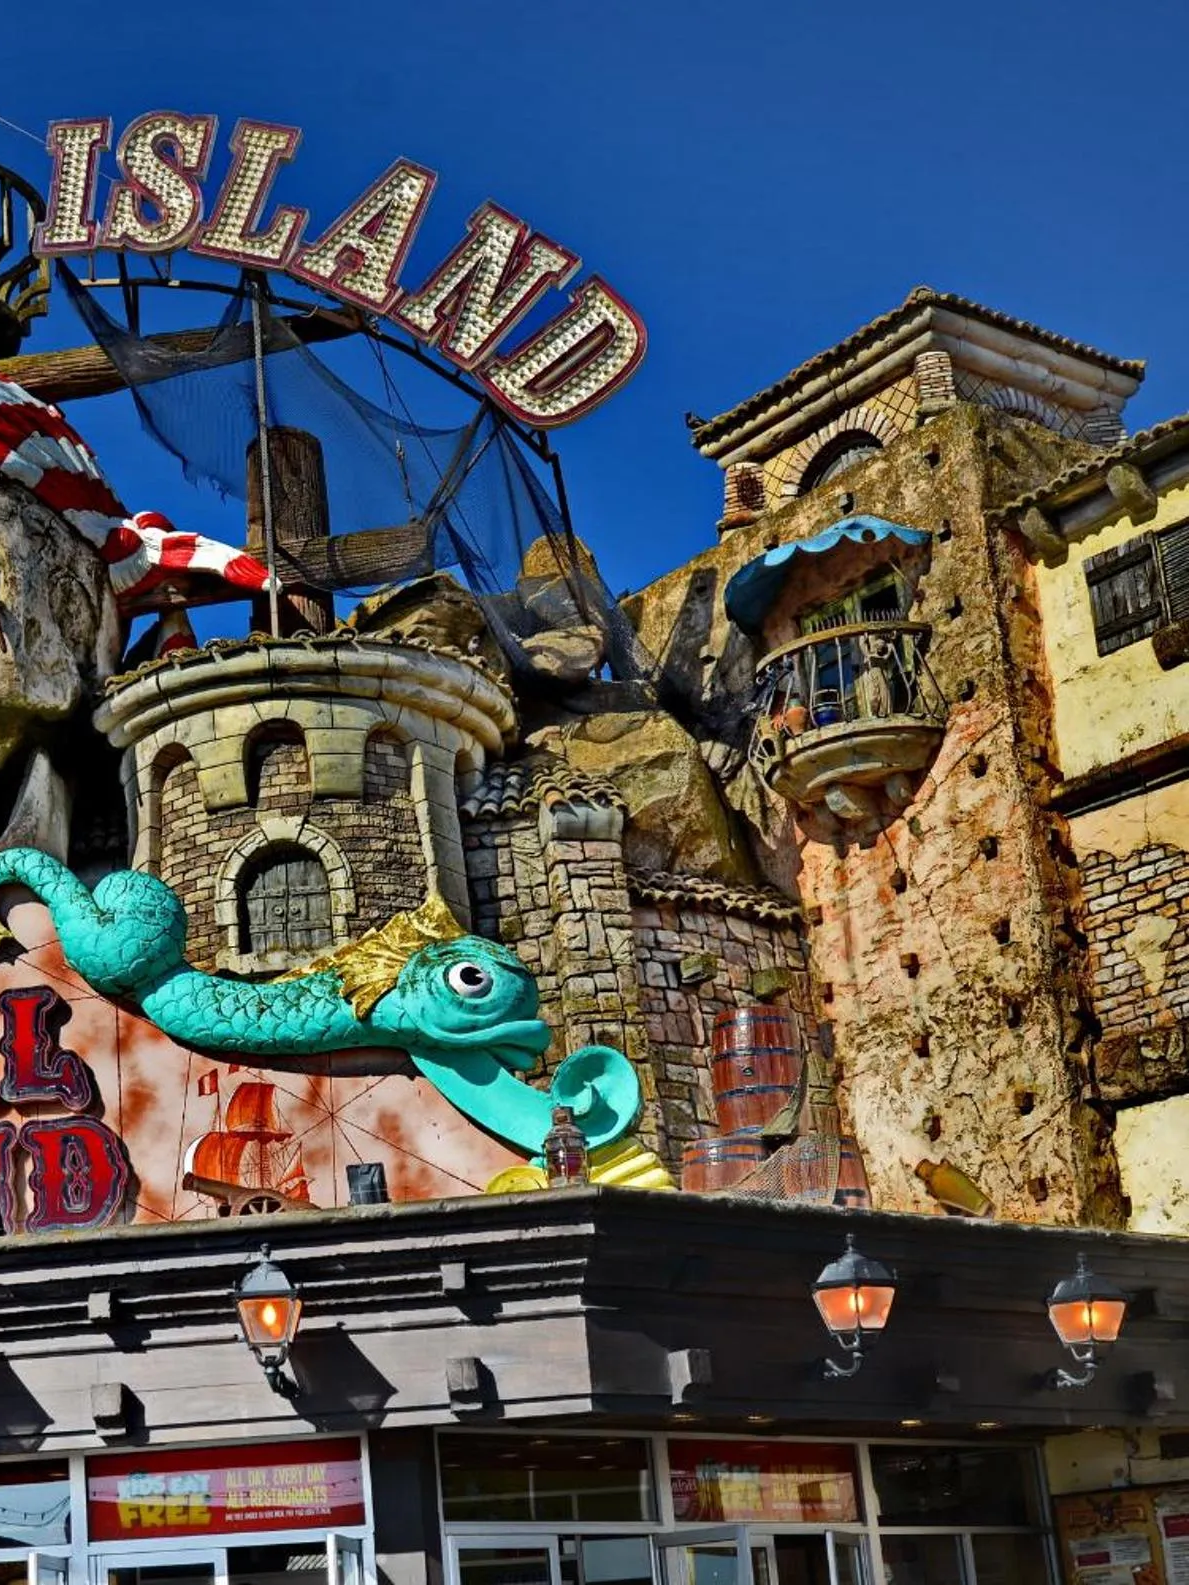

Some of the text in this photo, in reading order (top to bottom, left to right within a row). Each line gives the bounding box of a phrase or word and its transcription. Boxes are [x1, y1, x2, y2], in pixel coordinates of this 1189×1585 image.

[33, 111, 647, 430] ISLAND
[117, 1473, 211, 1500] KIDS EAT
[226, 1471, 243, 1488] ALL
[273, 1465, 303, 1483] EVERY
[306, 1463, 327, 1482] DAY
[118, 1494, 212, 1528] FREE
[226, 1486, 329, 1509] ALL RESTAURANTS
